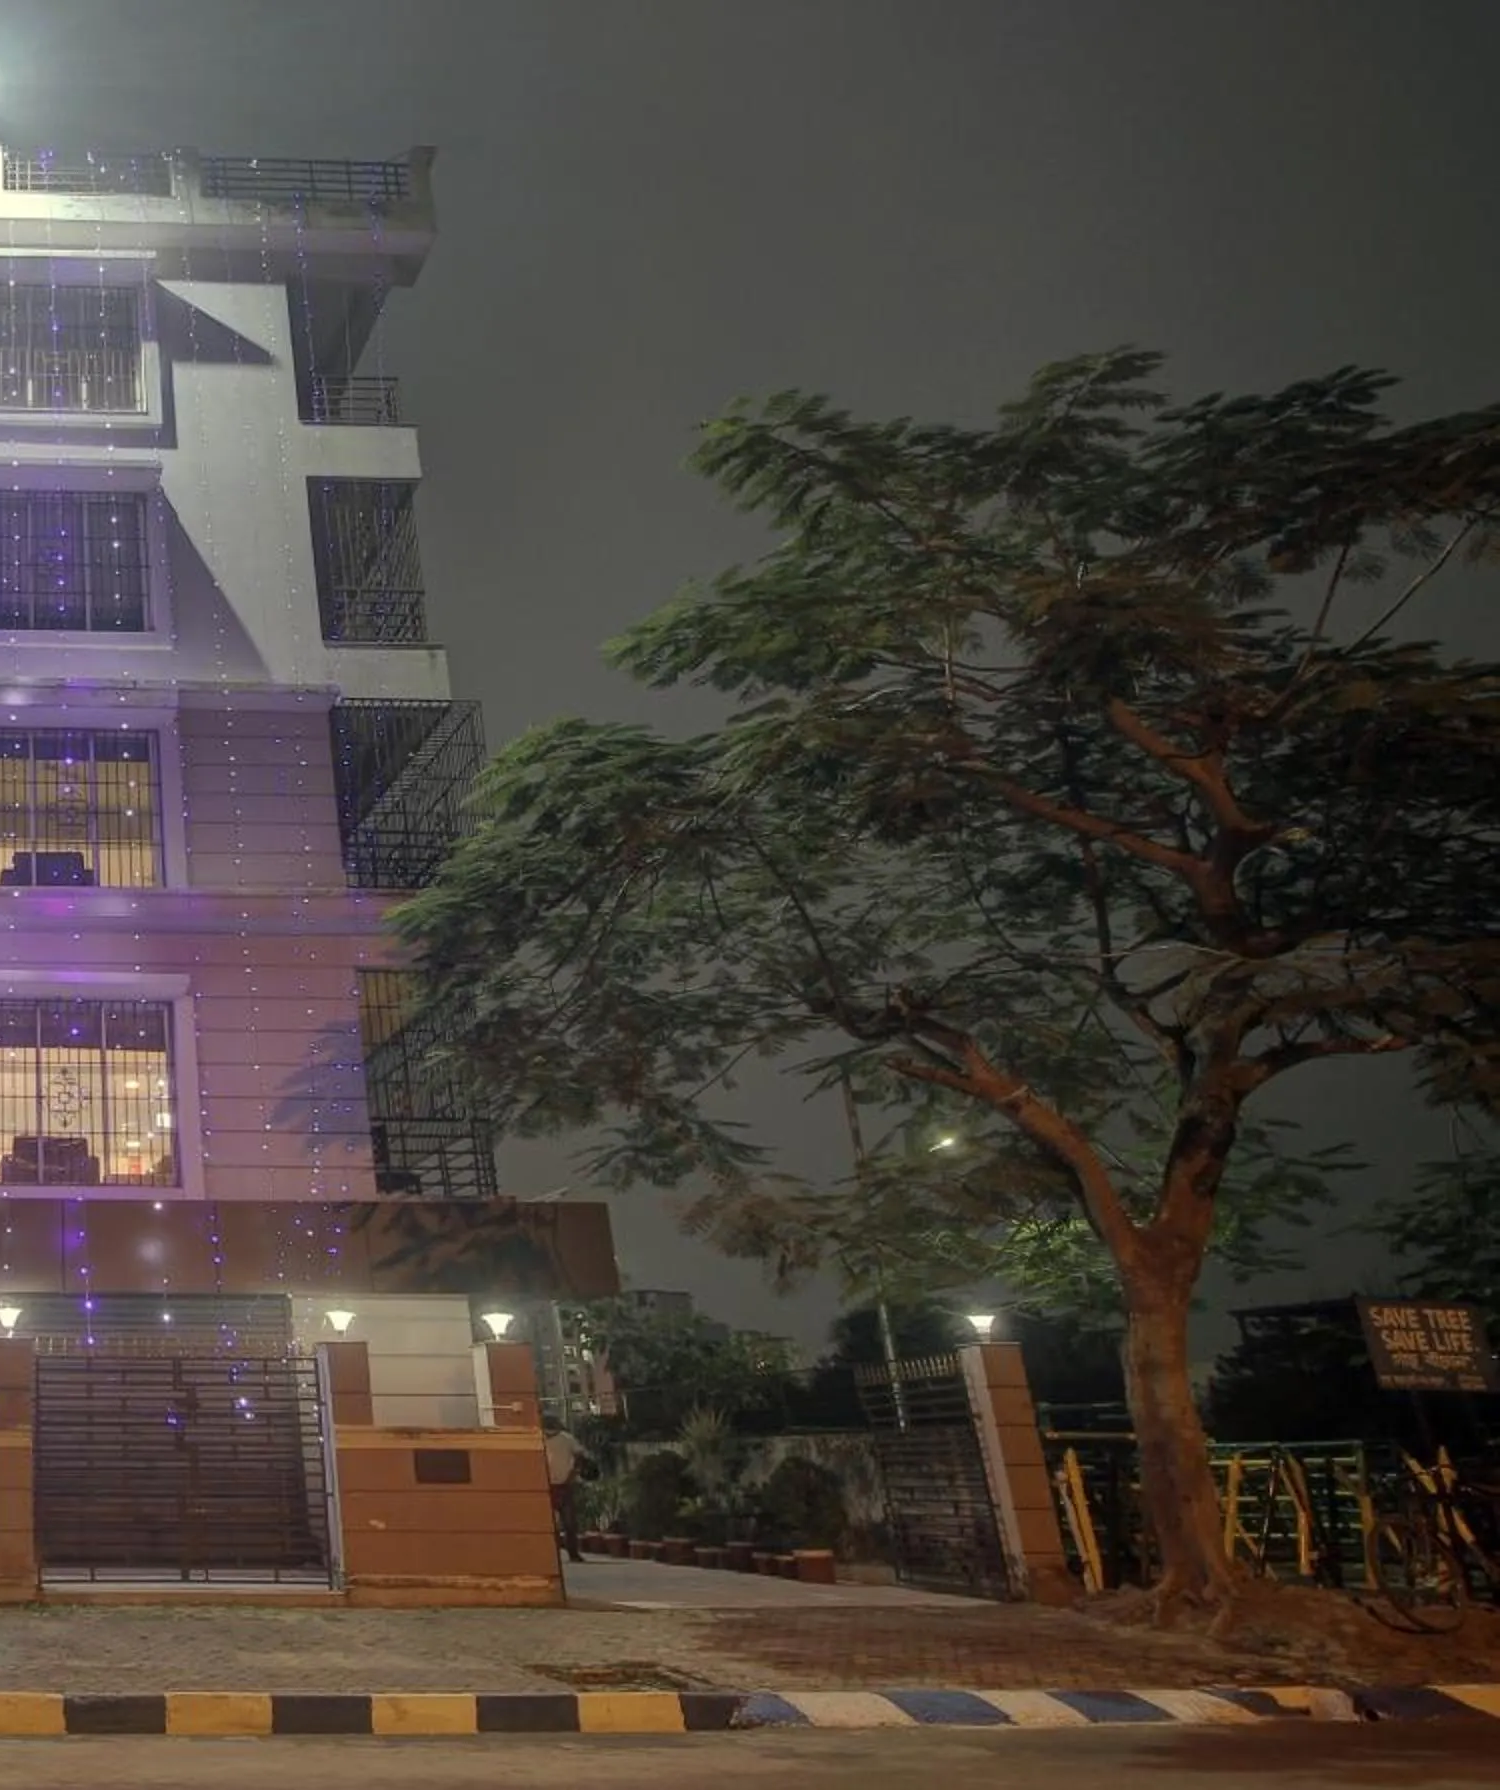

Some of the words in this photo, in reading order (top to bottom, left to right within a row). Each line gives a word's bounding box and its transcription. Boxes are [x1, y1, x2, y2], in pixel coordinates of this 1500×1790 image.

[1368, 1307, 1421, 1328] SAVE
[1422, 1308, 1473, 1331] TREE
[1380, 1330, 1430, 1351] SAVE
